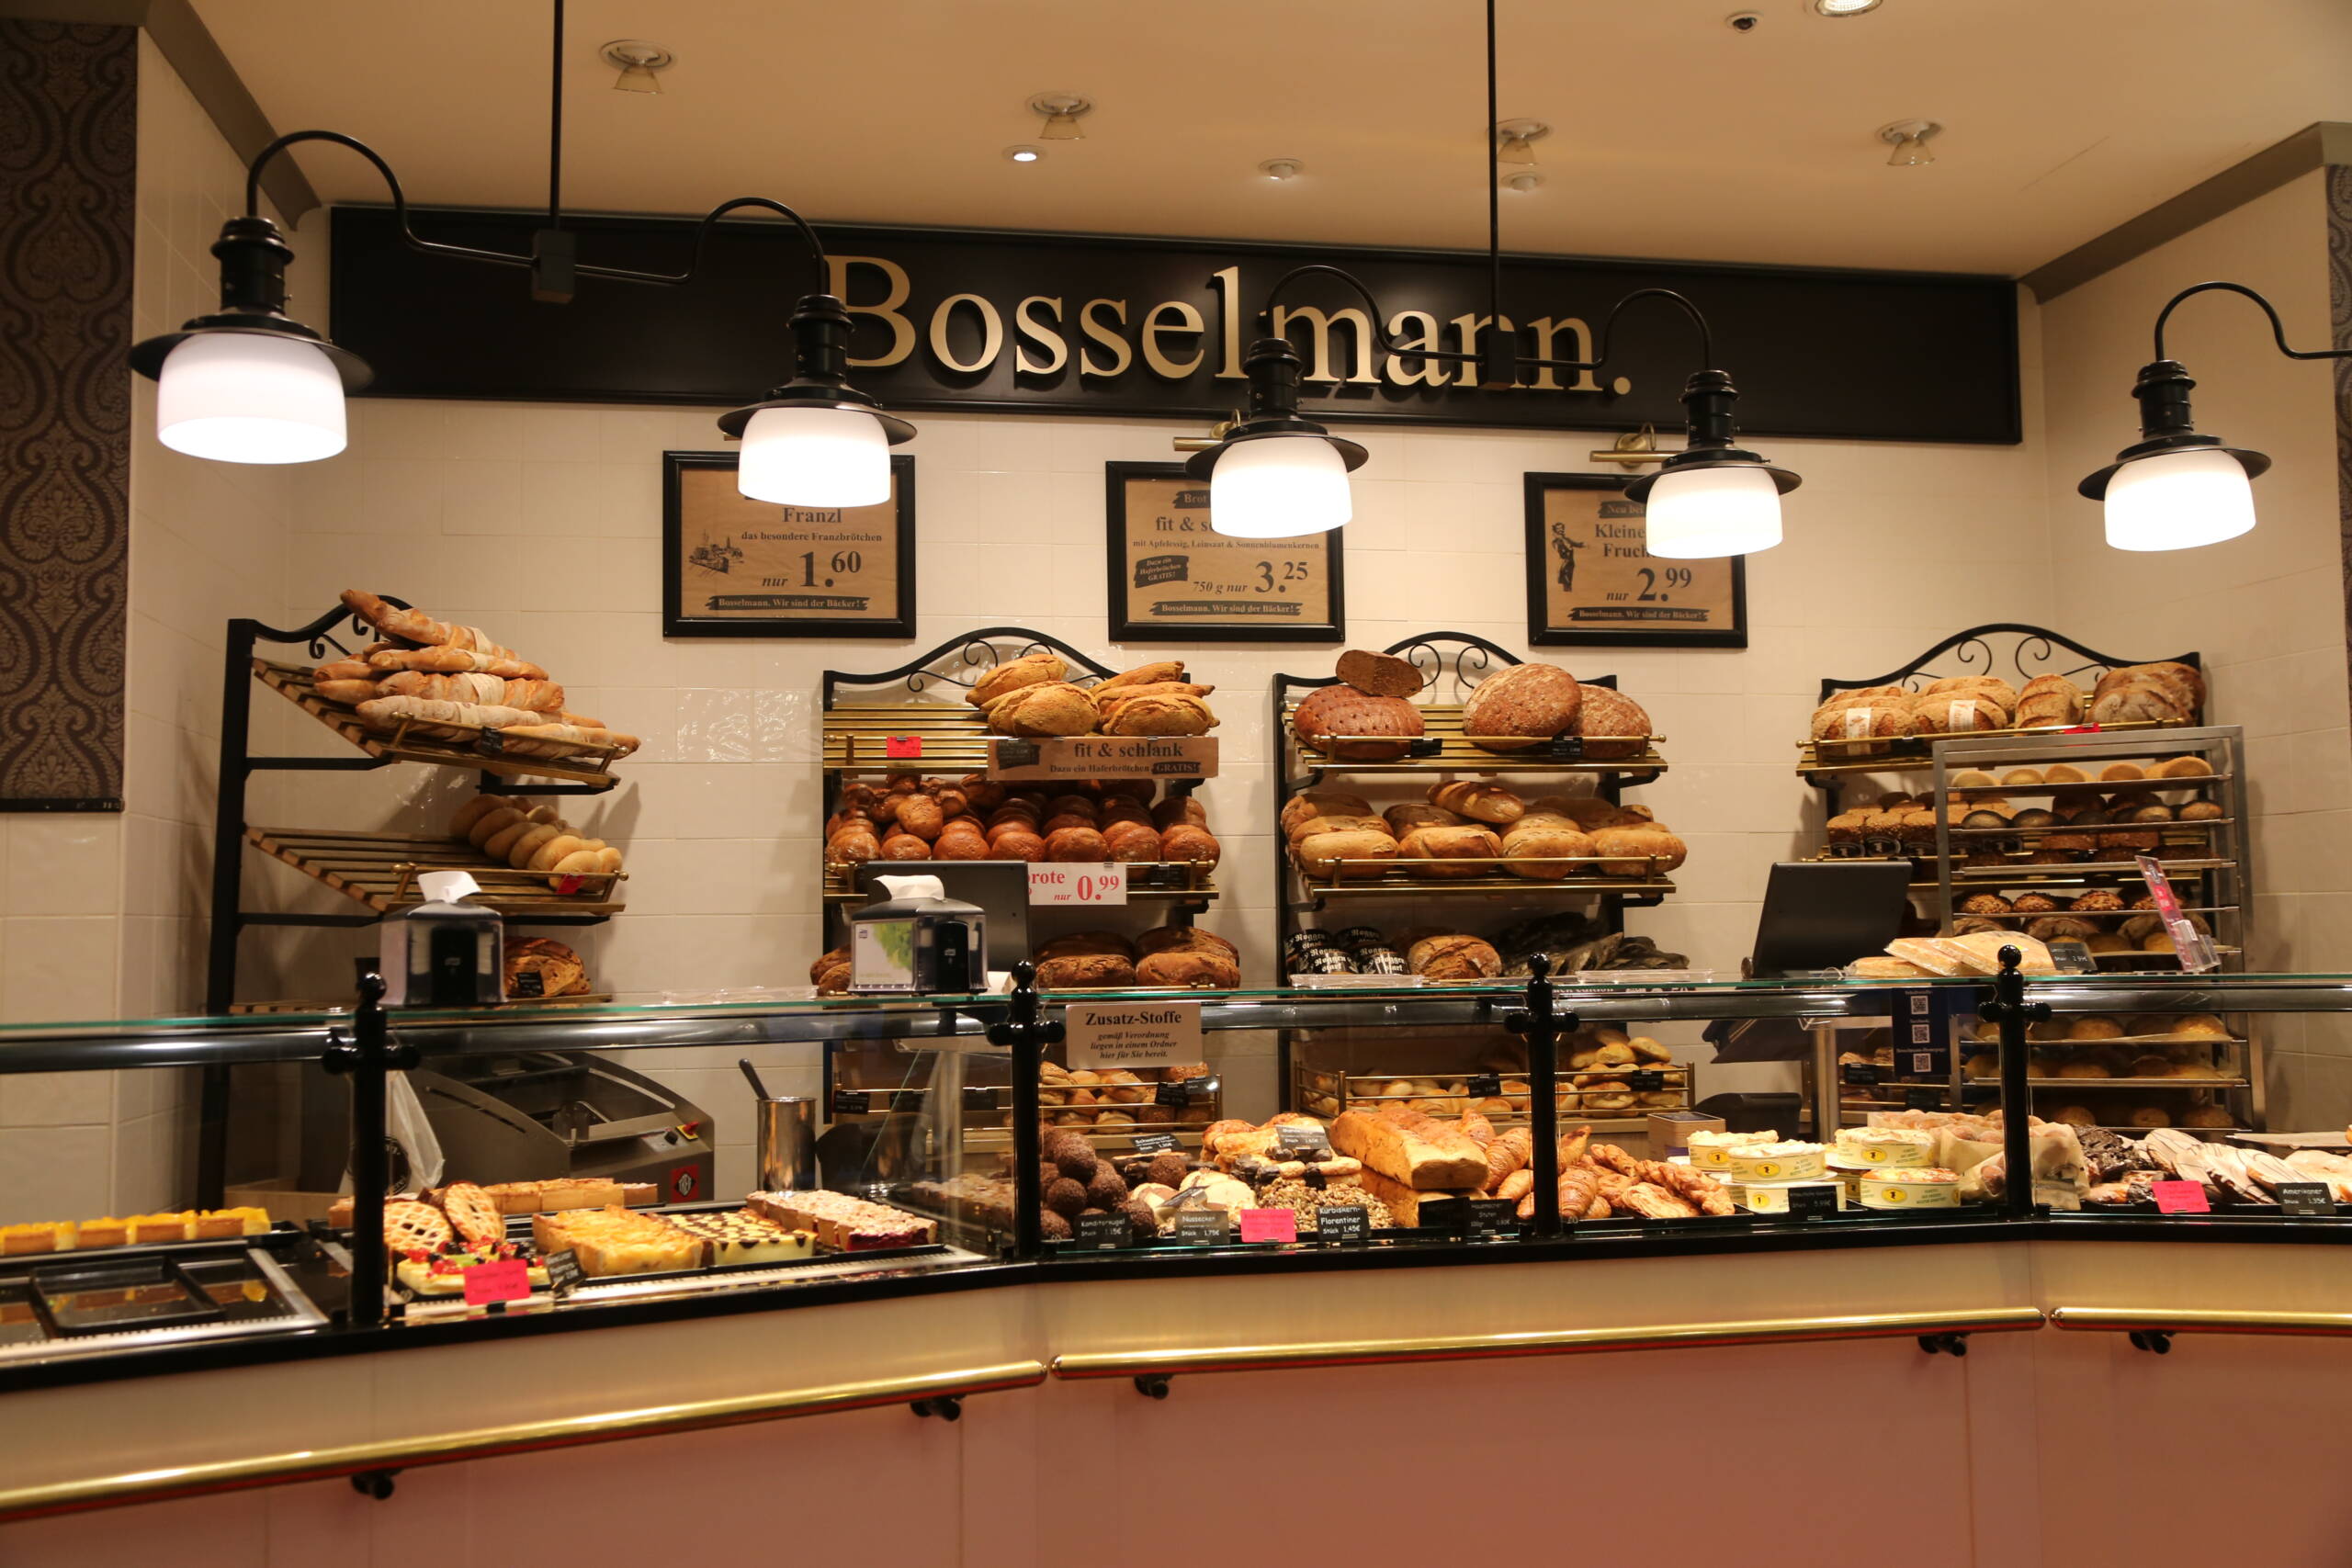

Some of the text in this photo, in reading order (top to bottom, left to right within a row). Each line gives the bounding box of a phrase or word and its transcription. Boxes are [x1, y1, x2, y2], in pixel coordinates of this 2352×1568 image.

[823, 254, 1631, 395] Bosselmann.
[783, 507, 842, 524] Franzl
[1156, 516, 1173, 531] fit
[1180, 515, 1194, 531] &
[1595, 524, 1646, 538] Kleine
[741, 532, 882, 542] das besondere Franzbrötchen
[1192, 540, 1225, 548] Leinsaat
[762, 576, 788, 587] nur
[1193, 581, 1213, 592] 750
[1215, 584, 1223, 594] g
[1227, 583, 1248, 592] nur
[1606, 592, 1629, 601] nur
[718, 599, 770, 607] Bosselmann.
[773, 599, 789, 607] Wir
[790, 599, 808, 607] sind
[810, 599, 824, 607] der
[1161, 604, 1209, 612] Bosselmann.
[1212, 604, 1227, 612] Wir
[1227, 604, 1246, 613] sind
[1248, 604, 1261, 612] der
[1626, 610, 1640, 618] Wir
[1659, 610, 1670, 618] der
[1074, 742, 1183, 758] fit & schlank
[1049, 764, 1071, 773] Dazu
[1073, 764, 1086, 773] ein
[1156, 762, 1199, 773] GRATIS!
[1086, 1010, 1182, 1025] Zusatz-Stoffe
[1098, 1031, 1170, 1041] gemäß Verordnung
[1116, 1052, 1129, 1060] für
[1145, 1050, 1168, 1058] bereit.
[1320, 1216, 1362, 1225] Florentiner
[1322, 1224, 1361, 1235] Stück 1,45€
